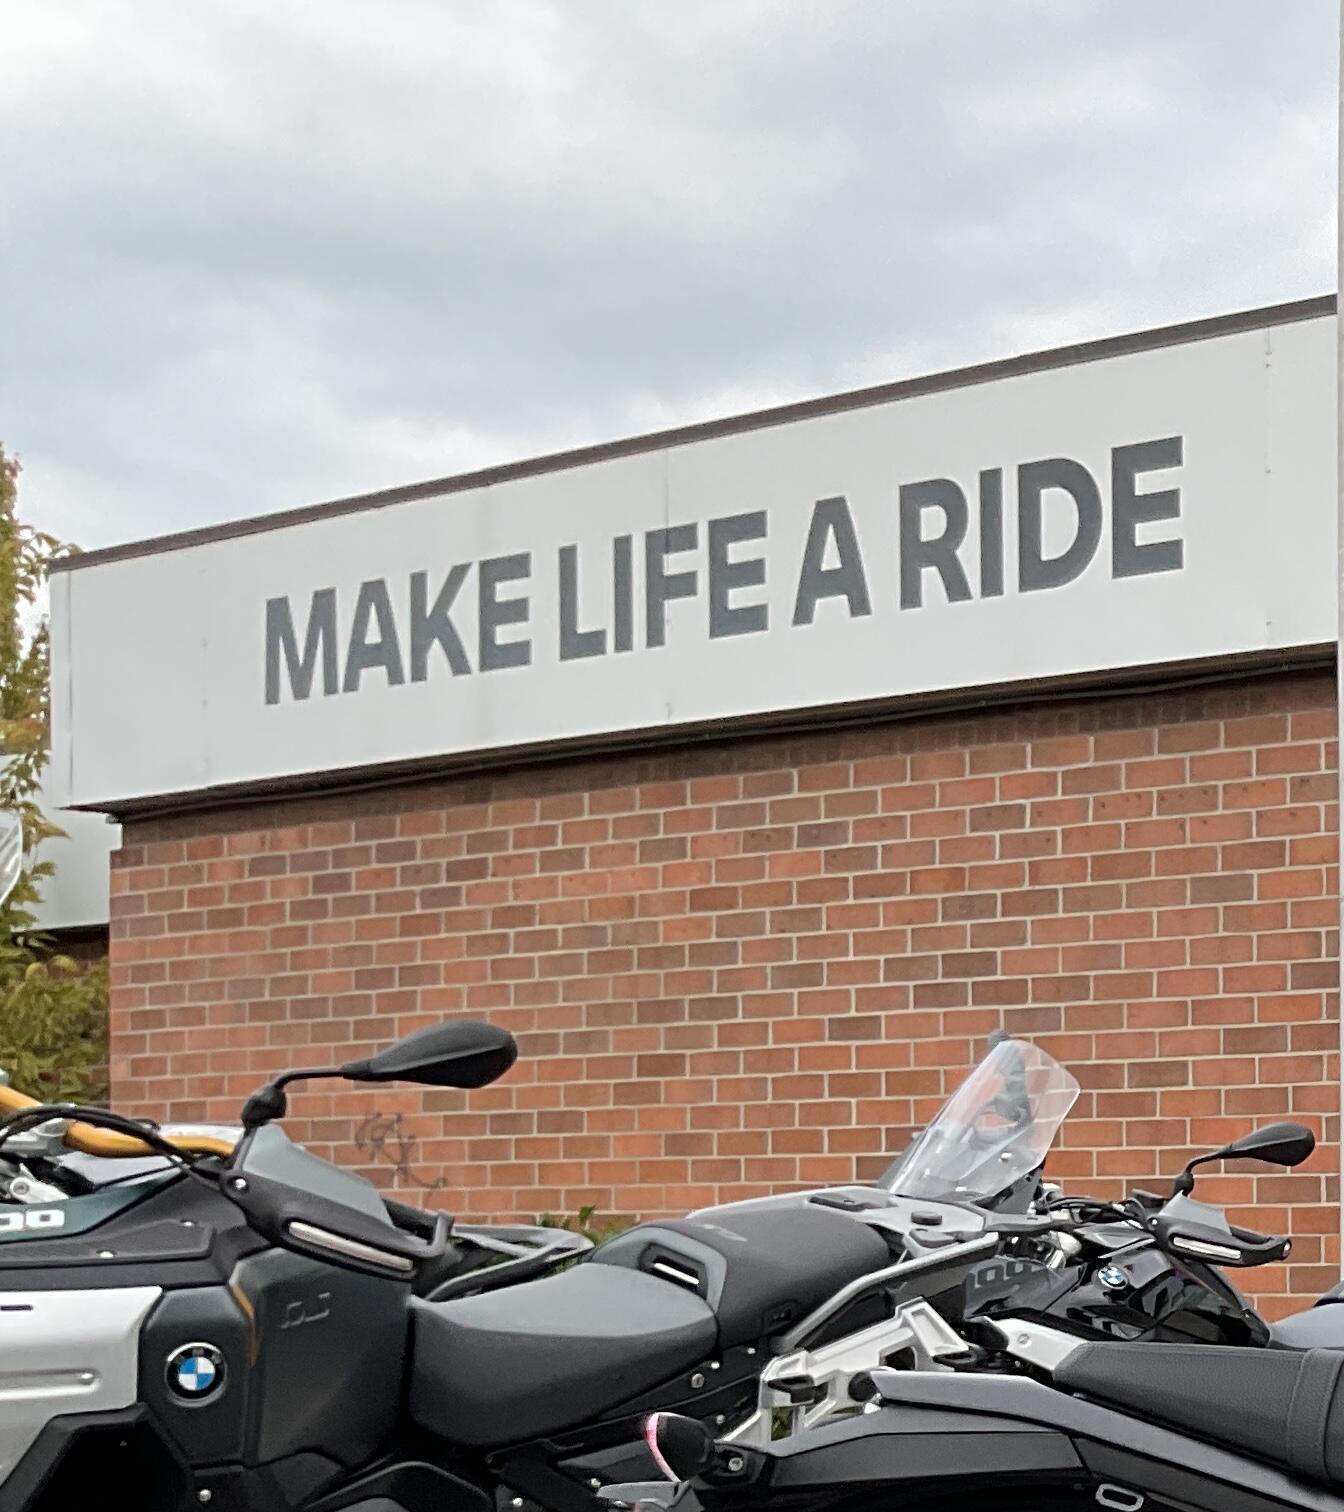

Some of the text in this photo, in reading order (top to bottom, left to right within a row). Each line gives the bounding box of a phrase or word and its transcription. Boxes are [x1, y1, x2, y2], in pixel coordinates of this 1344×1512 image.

[264, 435, 1184, 706] MAKE LIFE A RIDE
